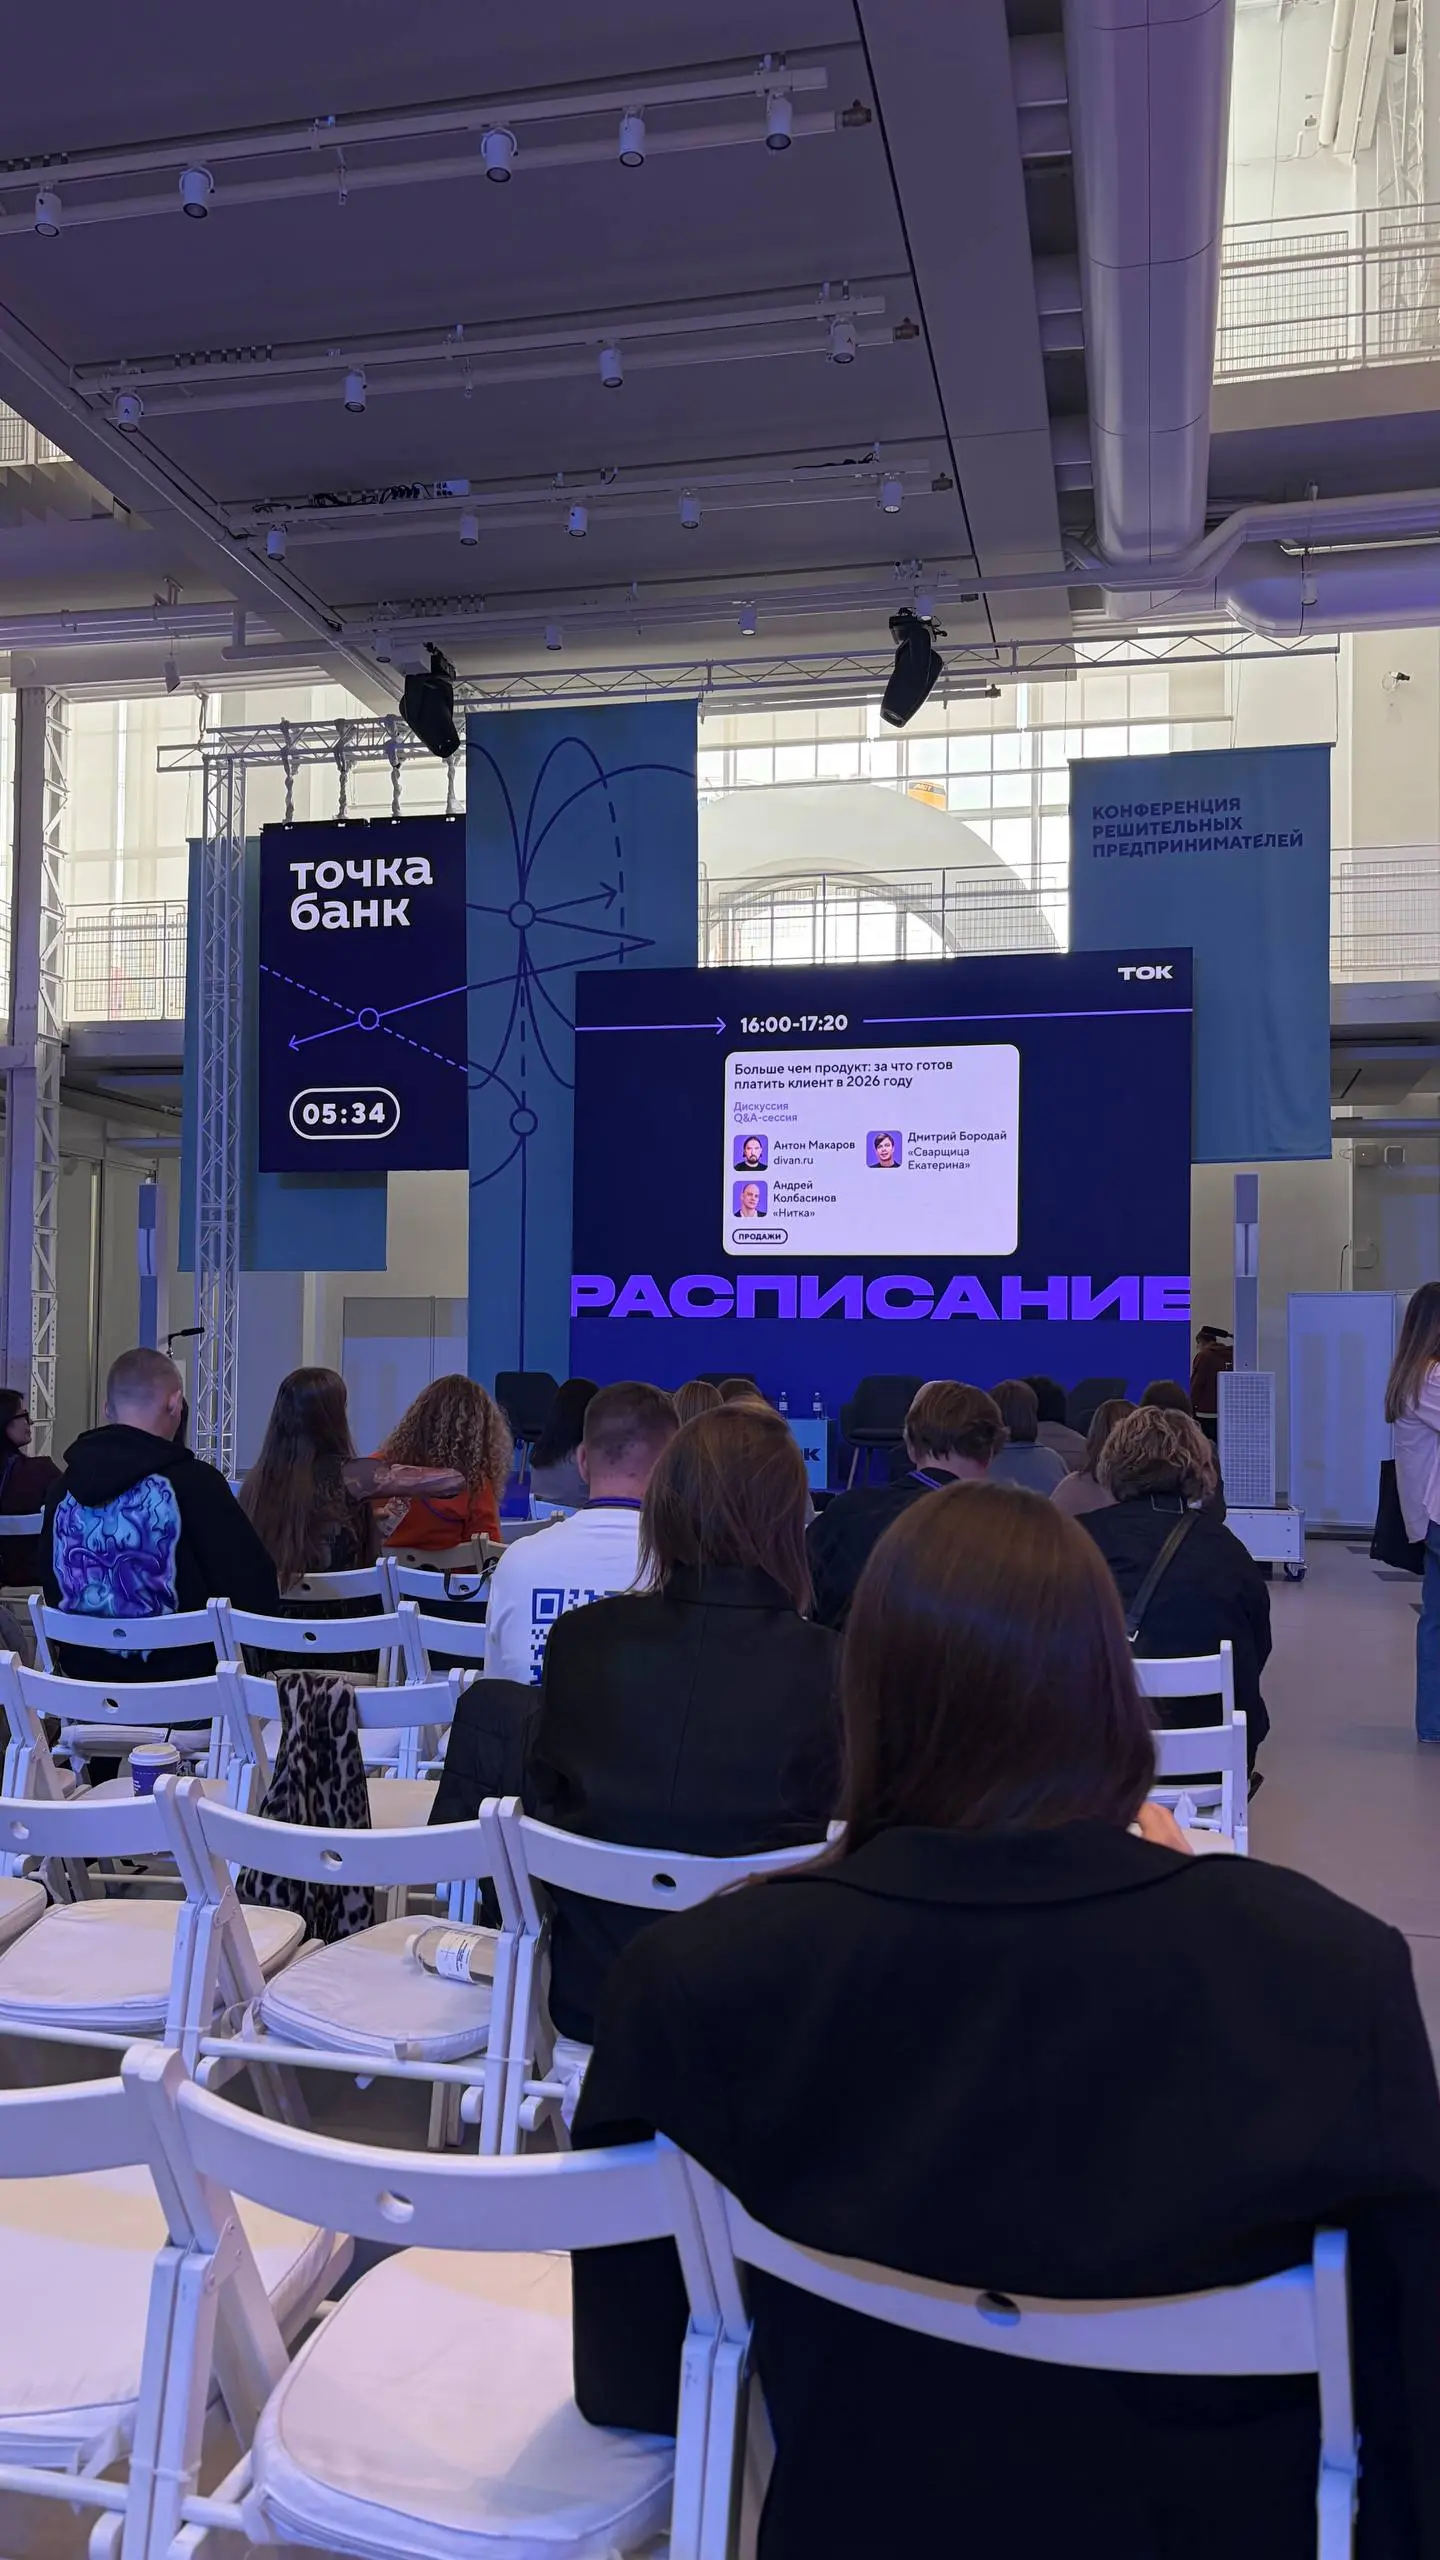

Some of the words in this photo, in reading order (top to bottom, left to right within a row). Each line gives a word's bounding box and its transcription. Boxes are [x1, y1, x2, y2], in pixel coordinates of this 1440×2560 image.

[1092, 797, 1241, 820] КОНФЕРЕНЦИЯ
[1092, 816, 1243, 839] РЕШИТЕЛЬНЫХ
[1092, 829, 1304, 858] ПРЕДПРИНИМАТЕЛЕЙ
[289, 857, 433, 890] точка
[290, 892, 411, 931] банк
[1117, 965, 1174, 981] ТОК
[740, 1014, 849, 1033] 16:00-17:20
[734, 1063, 785, 1075] Больше
[787, 1065, 812, 1074] чем
[814, 1062, 871, 1075] продукт:
[873, 1063, 888, 1072] за
[891, 1062, 914, 1072] что
[916, 1061, 953, 1071] готов
[734, 1078, 785, 1090] платить
[788, 1078, 834, 1088] клиент
[836, 1078, 844, 1087] в
[846, 1075, 881, 1087] 2026
[883, 1076, 913, 1088] году
[733, 1101, 789, 1112] Дискуссия
[302, 1103, 386, 1125] 05:34
[733, 1112, 798, 1123] Q&A-сессия
[907, 1132, 957, 1143] Дмитрий
[959, 1131, 1007, 1142] Бородай
[773, 1140, 806, 1150] Антон
[808, 1140, 856, 1151] Макаров
[908, 1147, 970, 1158] «Сварщица
[773, 1155, 814, 1165] divan.ru
[908, 1160, 971, 1171] Екатерина»
[773, 1180, 813, 1192] Андрей
[773, 1193, 837, 1203] Колбасинов
[773, 1208, 816, 1218] «Нитка»
[738, 1233, 782, 1241] ПРОДАЖИ
[571, 1274, 1191, 1321] РАСПИСАНИЕ
